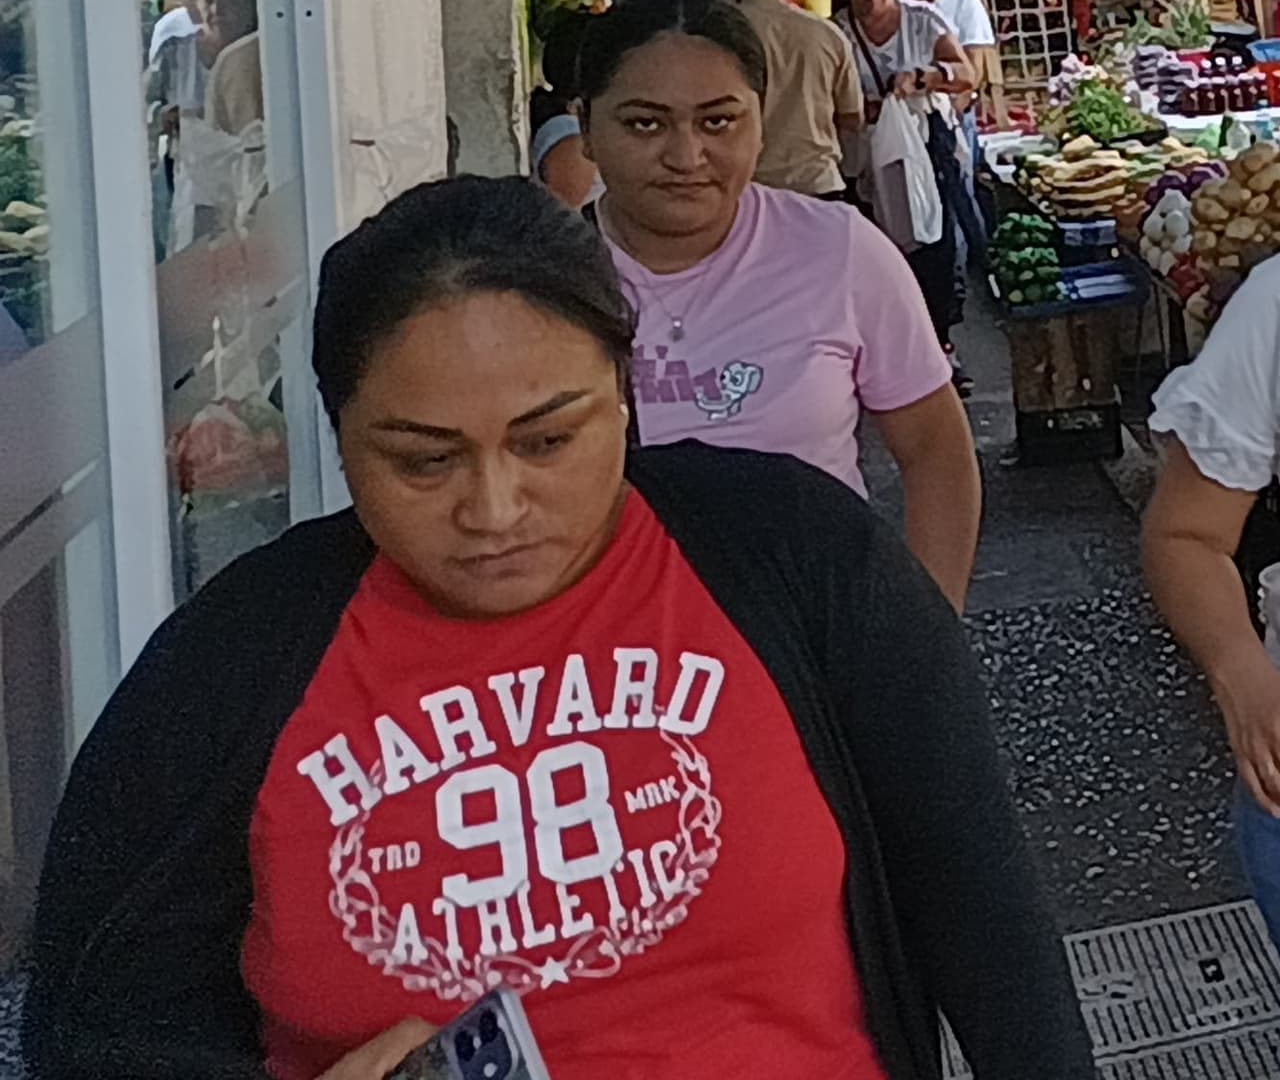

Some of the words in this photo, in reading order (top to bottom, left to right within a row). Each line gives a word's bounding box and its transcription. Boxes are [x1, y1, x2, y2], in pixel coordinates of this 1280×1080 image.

[297, 647, 724, 826] HARVARD
[391, 839, 685, 966] ATHLETIC
[435, 741, 623, 908] 98
